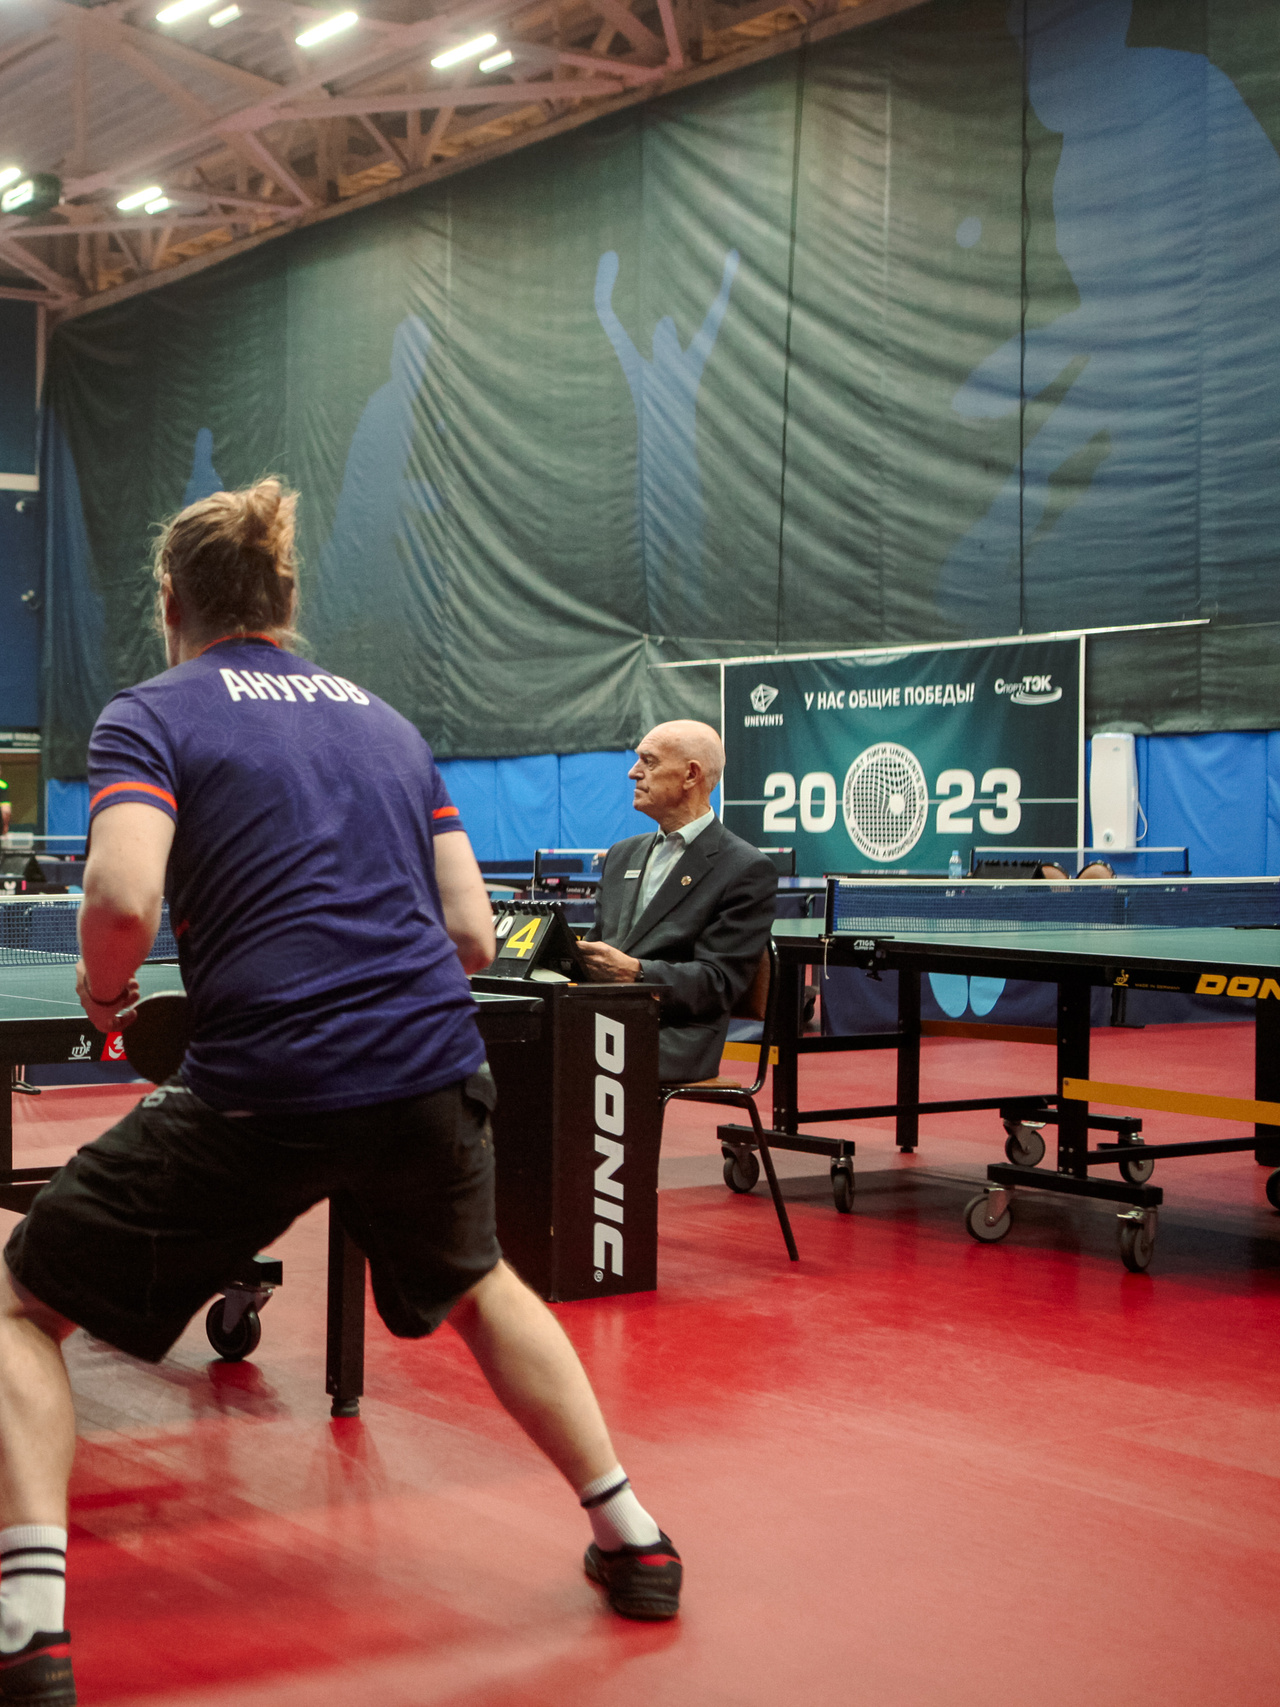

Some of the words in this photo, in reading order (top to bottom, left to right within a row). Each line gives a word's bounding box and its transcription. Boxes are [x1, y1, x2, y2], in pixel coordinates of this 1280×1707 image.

[219, 668, 370, 706] АНУРОВ
[804, 691, 815, 711] У
[817, 690, 846, 711] НАС
[848, 687, 901, 711] ОБЩИЕ
[904, 683, 975, 707] ПОБЕДЫ!
[744, 714, 784, 728] UNEVENTS
[763, 771, 837, 833] 20
[935, 767, 1022, 835] 23
[496, 916, 514, 937] 0
[506, 917, 542, 958] 4
